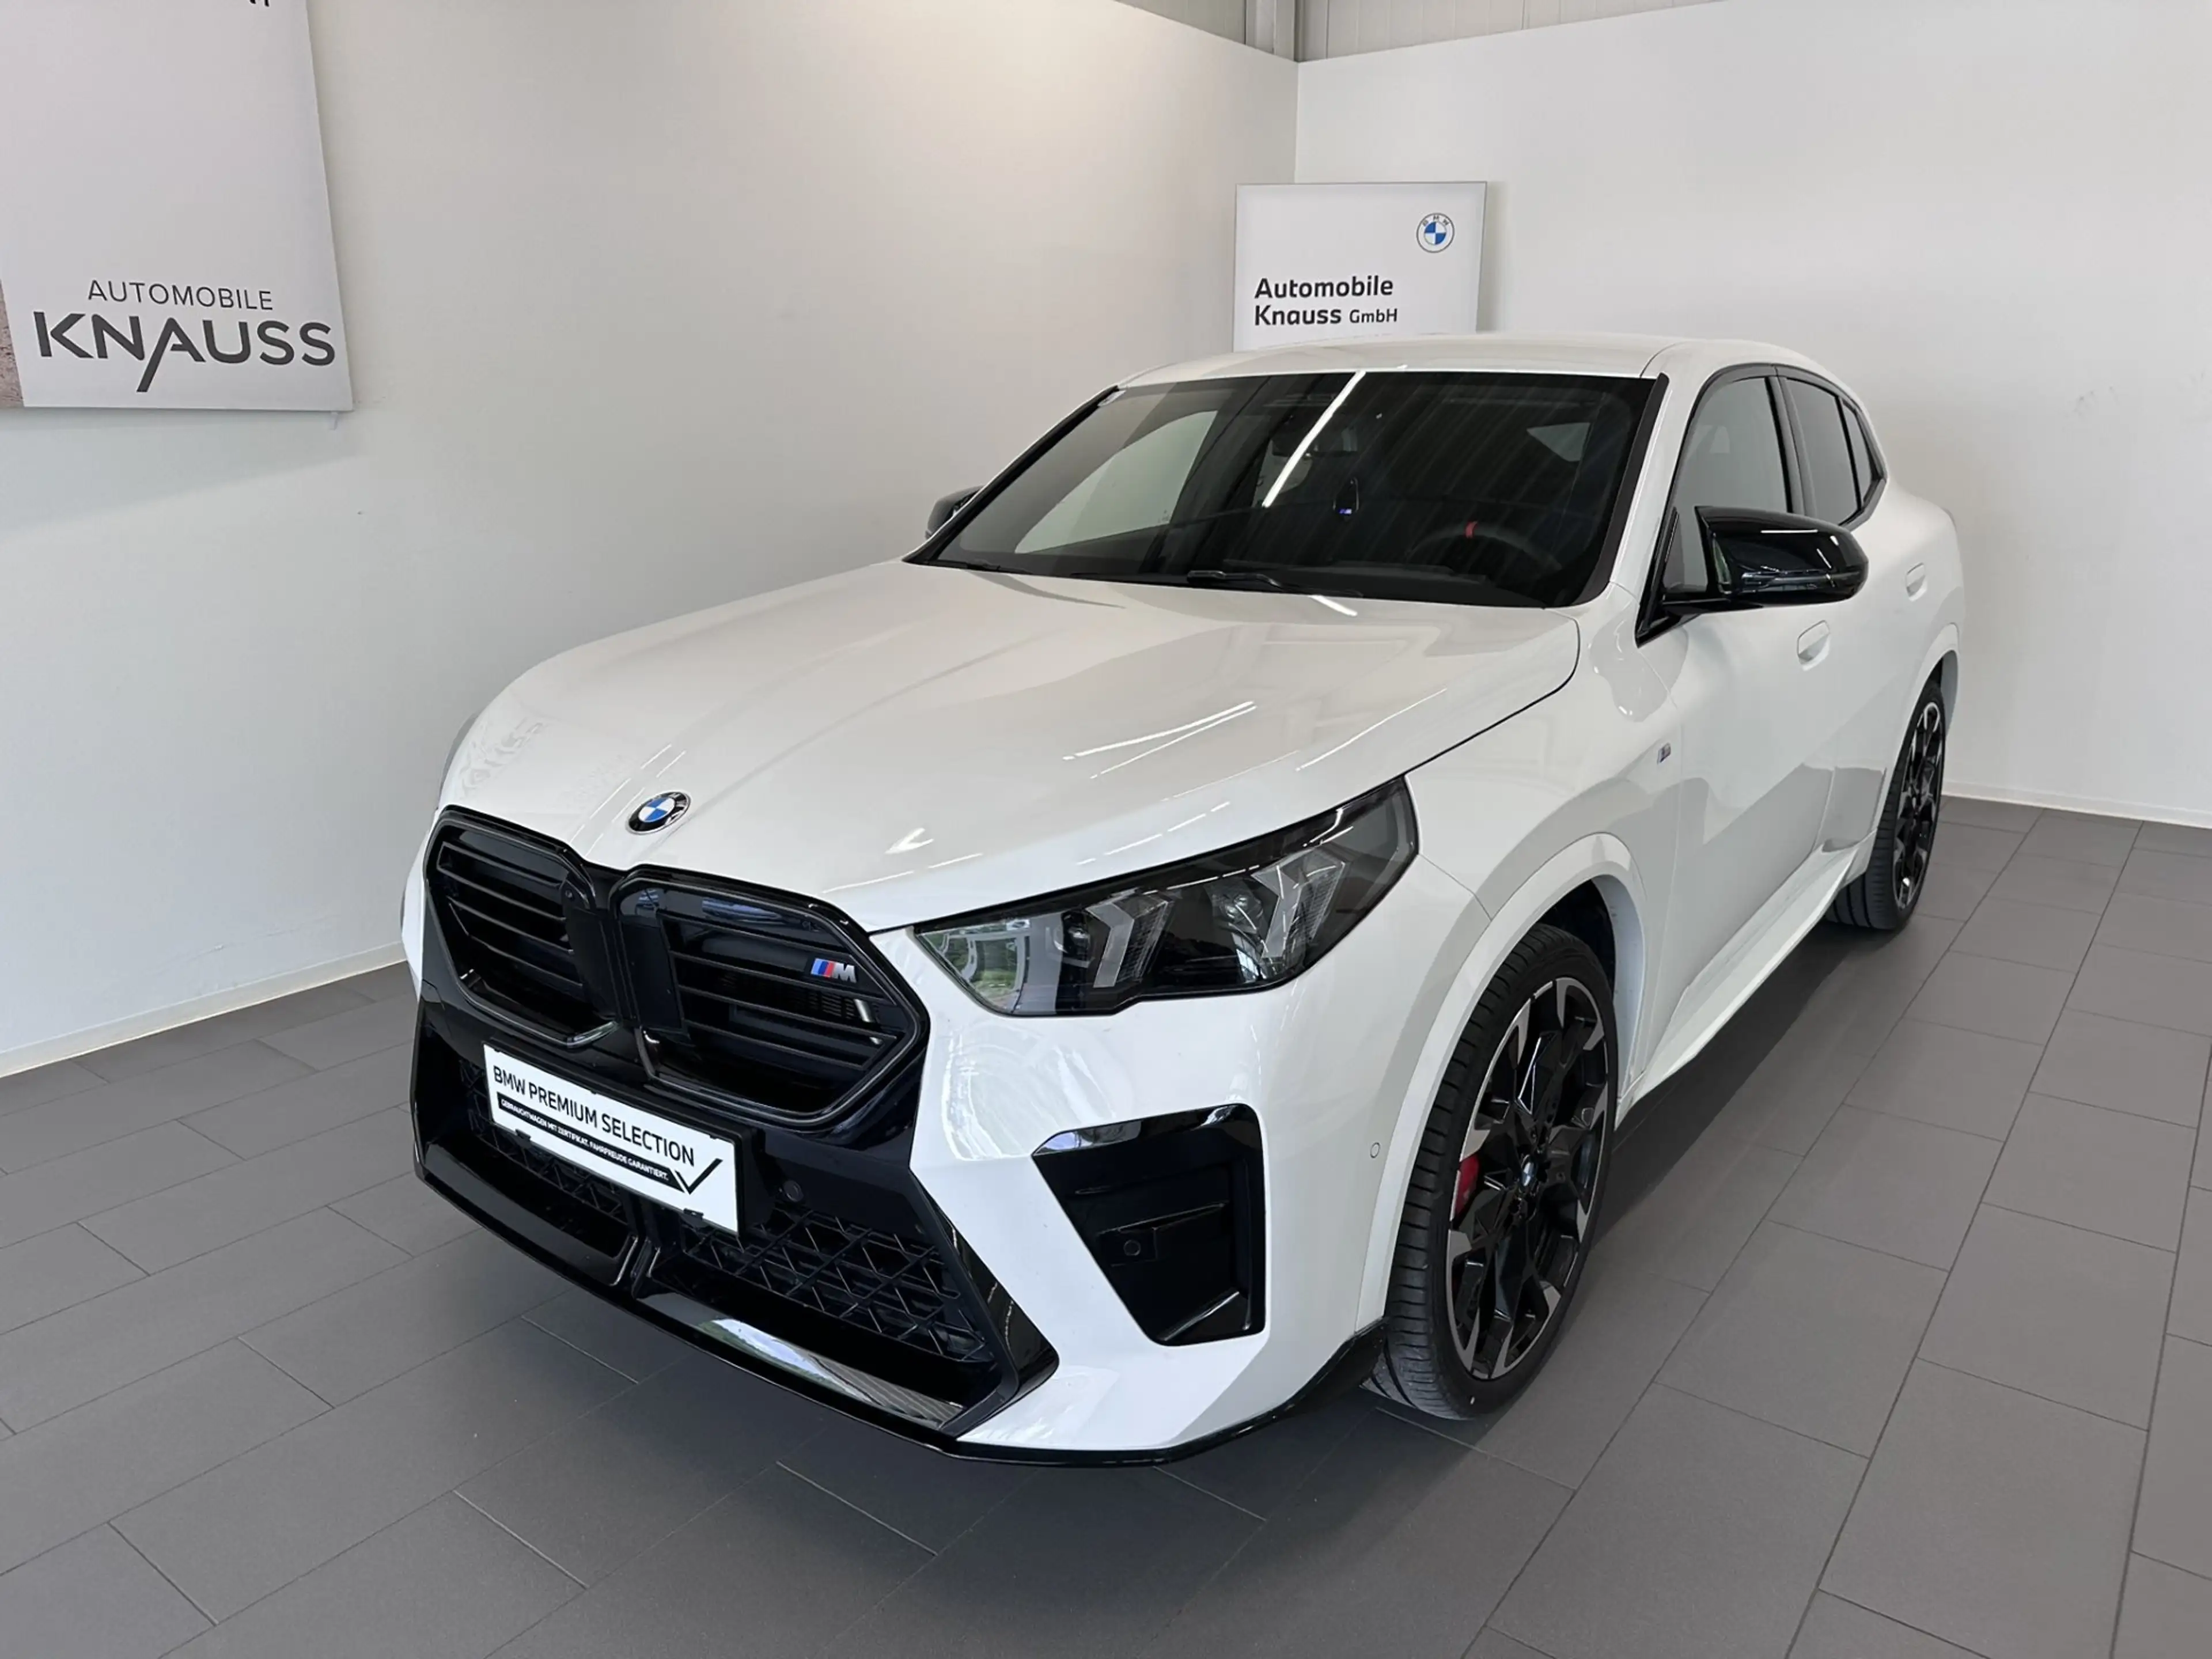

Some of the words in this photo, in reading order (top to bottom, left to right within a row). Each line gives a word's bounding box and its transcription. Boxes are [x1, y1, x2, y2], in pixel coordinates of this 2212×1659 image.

[88, 280, 273, 310] AUTOMOBILE
[1255, 275, 1393, 299] Automobile
[1255, 305, 1342, 326] Knauss
[1349, 309, 1397, 324] GmbH
[33, 311, 335, 393] KNAUSS
[494, 1066, 525, 1095] BMW
[529, 1083, 597, 1128] PREMIUM
[602, 1113, 694, 1166] SELECTION
